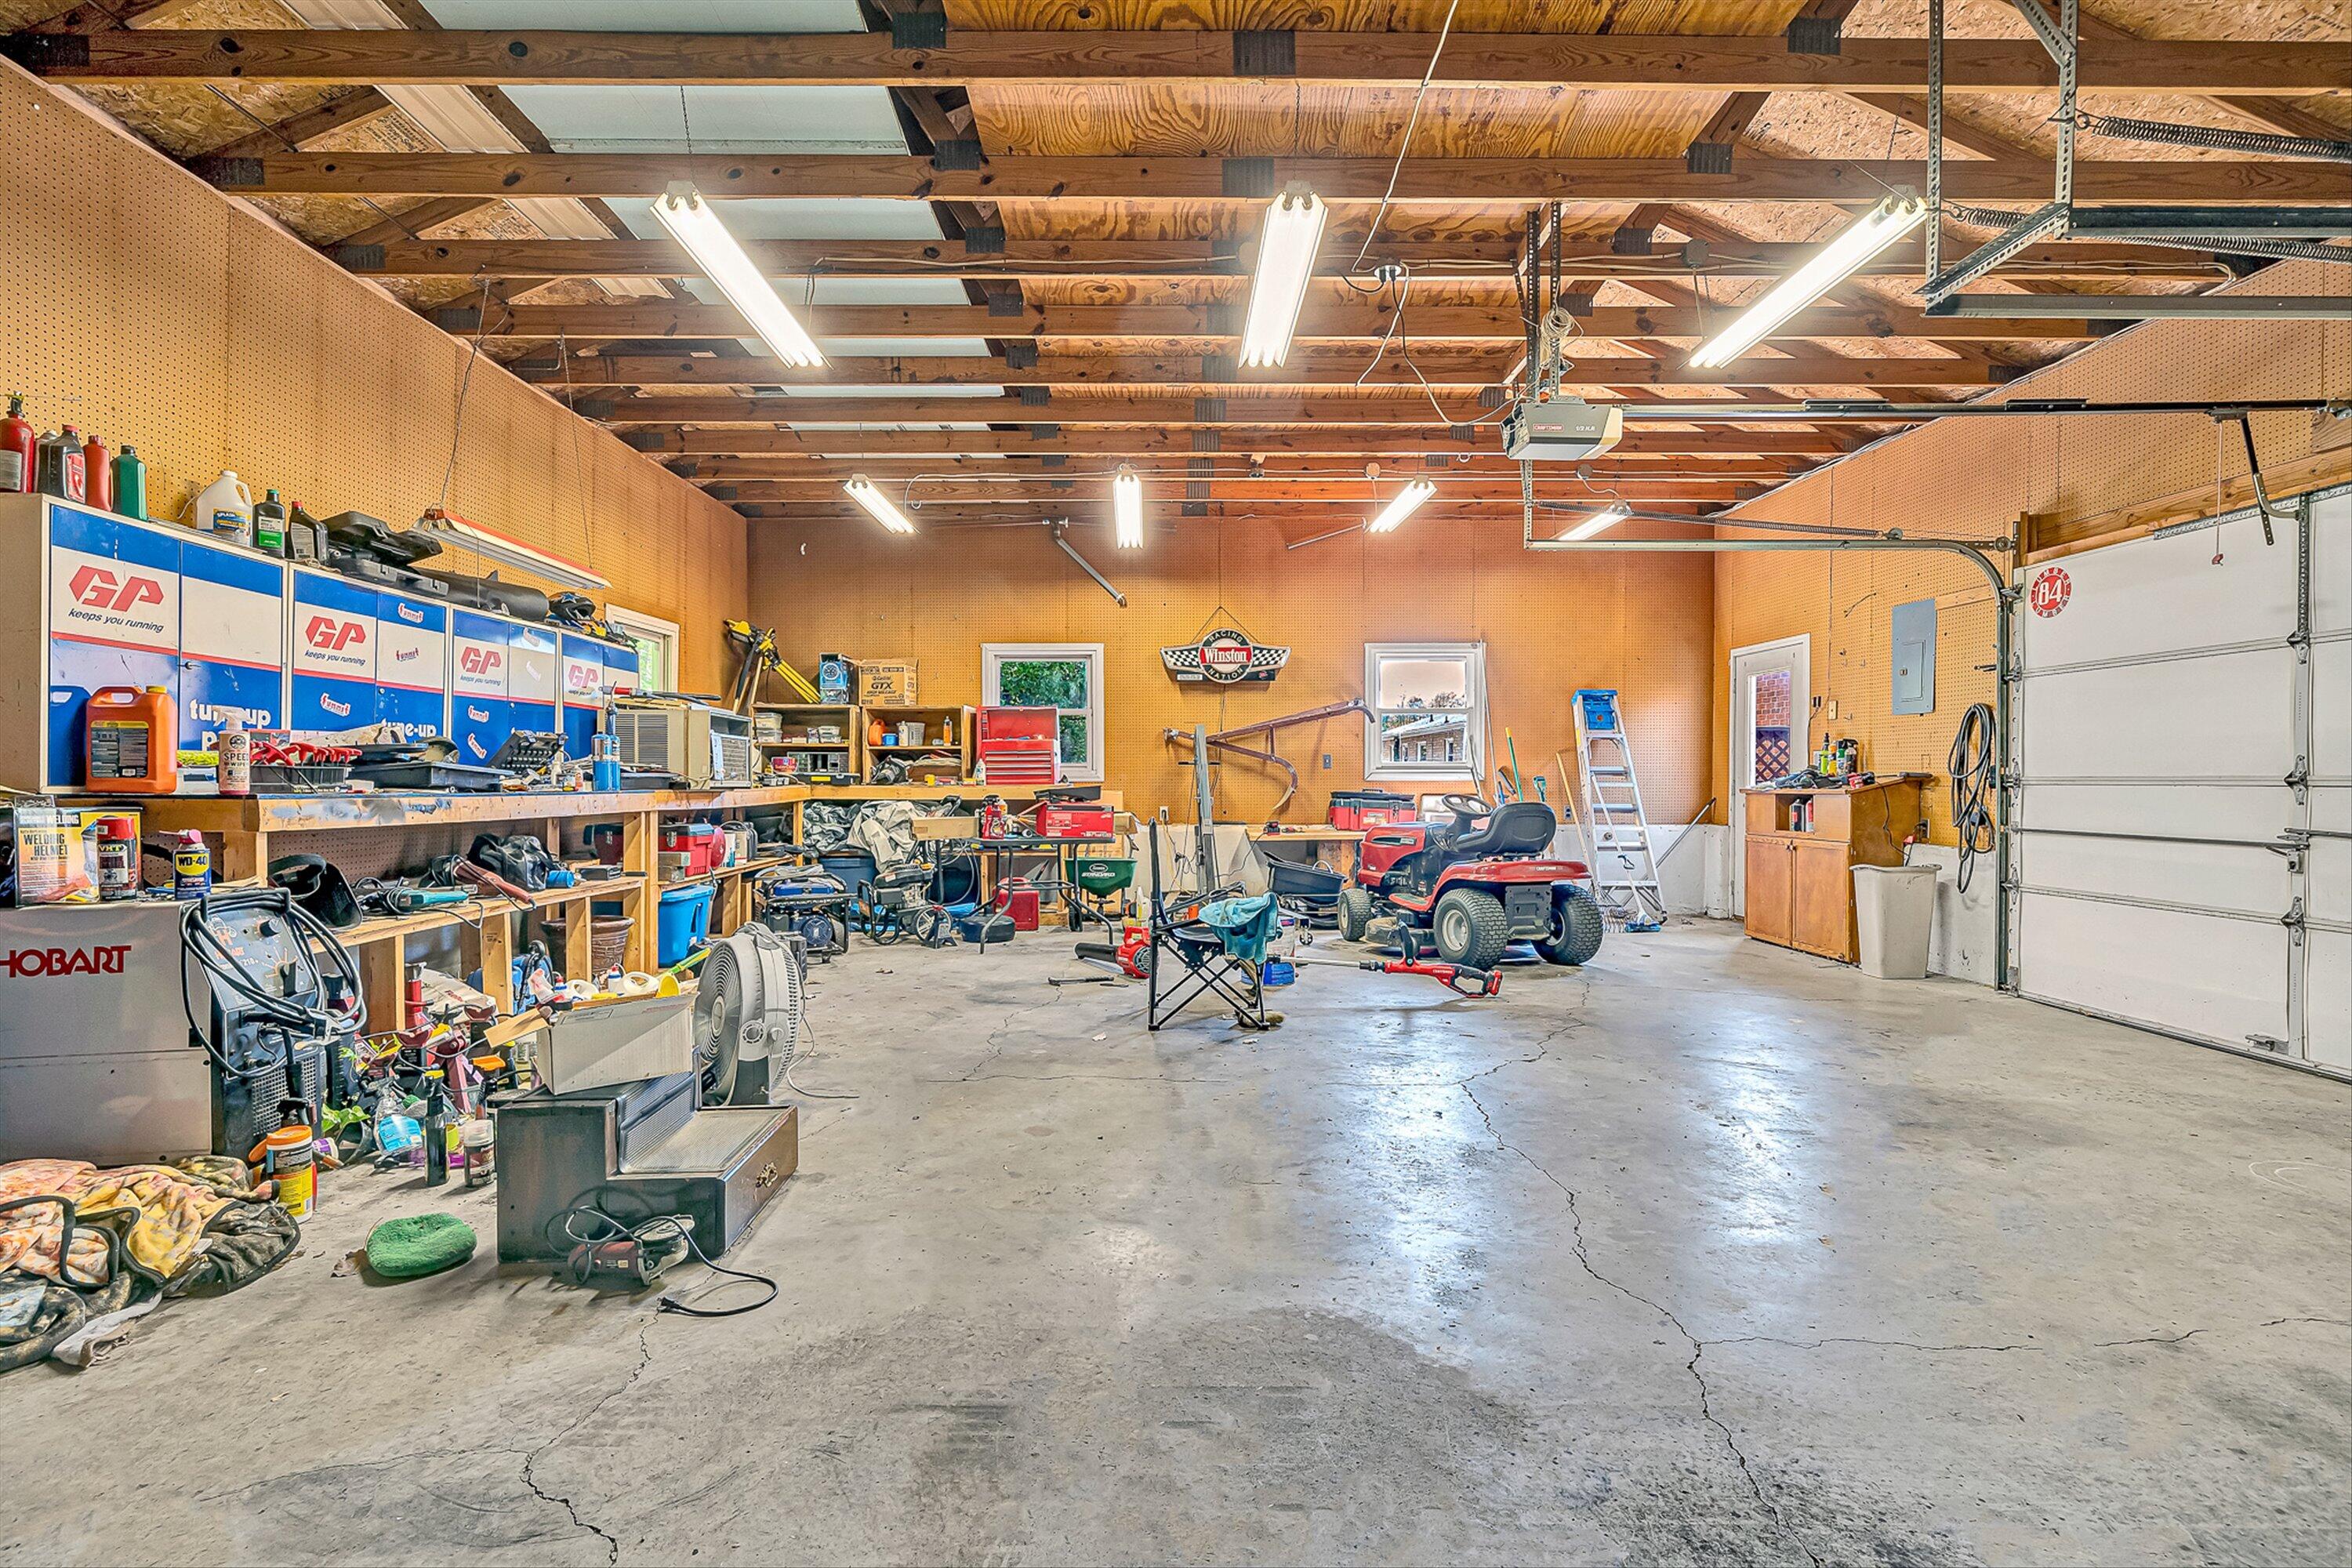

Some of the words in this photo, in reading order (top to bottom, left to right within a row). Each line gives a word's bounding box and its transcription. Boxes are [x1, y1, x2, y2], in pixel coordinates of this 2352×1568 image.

[69, 565, 164, 612] GP
[2038, 579, 2063, 605] 84
[68, 608, 102, 622] keeps
[103, 615, 124, 626] you
[125, 619, 165, 633] running
[305, 615, 366, 651] GP
[1208, 630, 1243, 643] RACING
[304, 649, 326, 659] keeps
[340, 655, 366, 666] running
[461, 647, 502, 674] GP
[1204, 648, 1248, 663] Winston
[568, 665, 598, 688] GP
[1208, 668, 1244, 681] NATION
[190, 699, 271, 728] tuup
[382, 717, 437, 738] te-up
[99, 844, 122, 853] VHT
[178, 855, 207, 866] WD-40
[0, 946, 131, 978] HOBART
